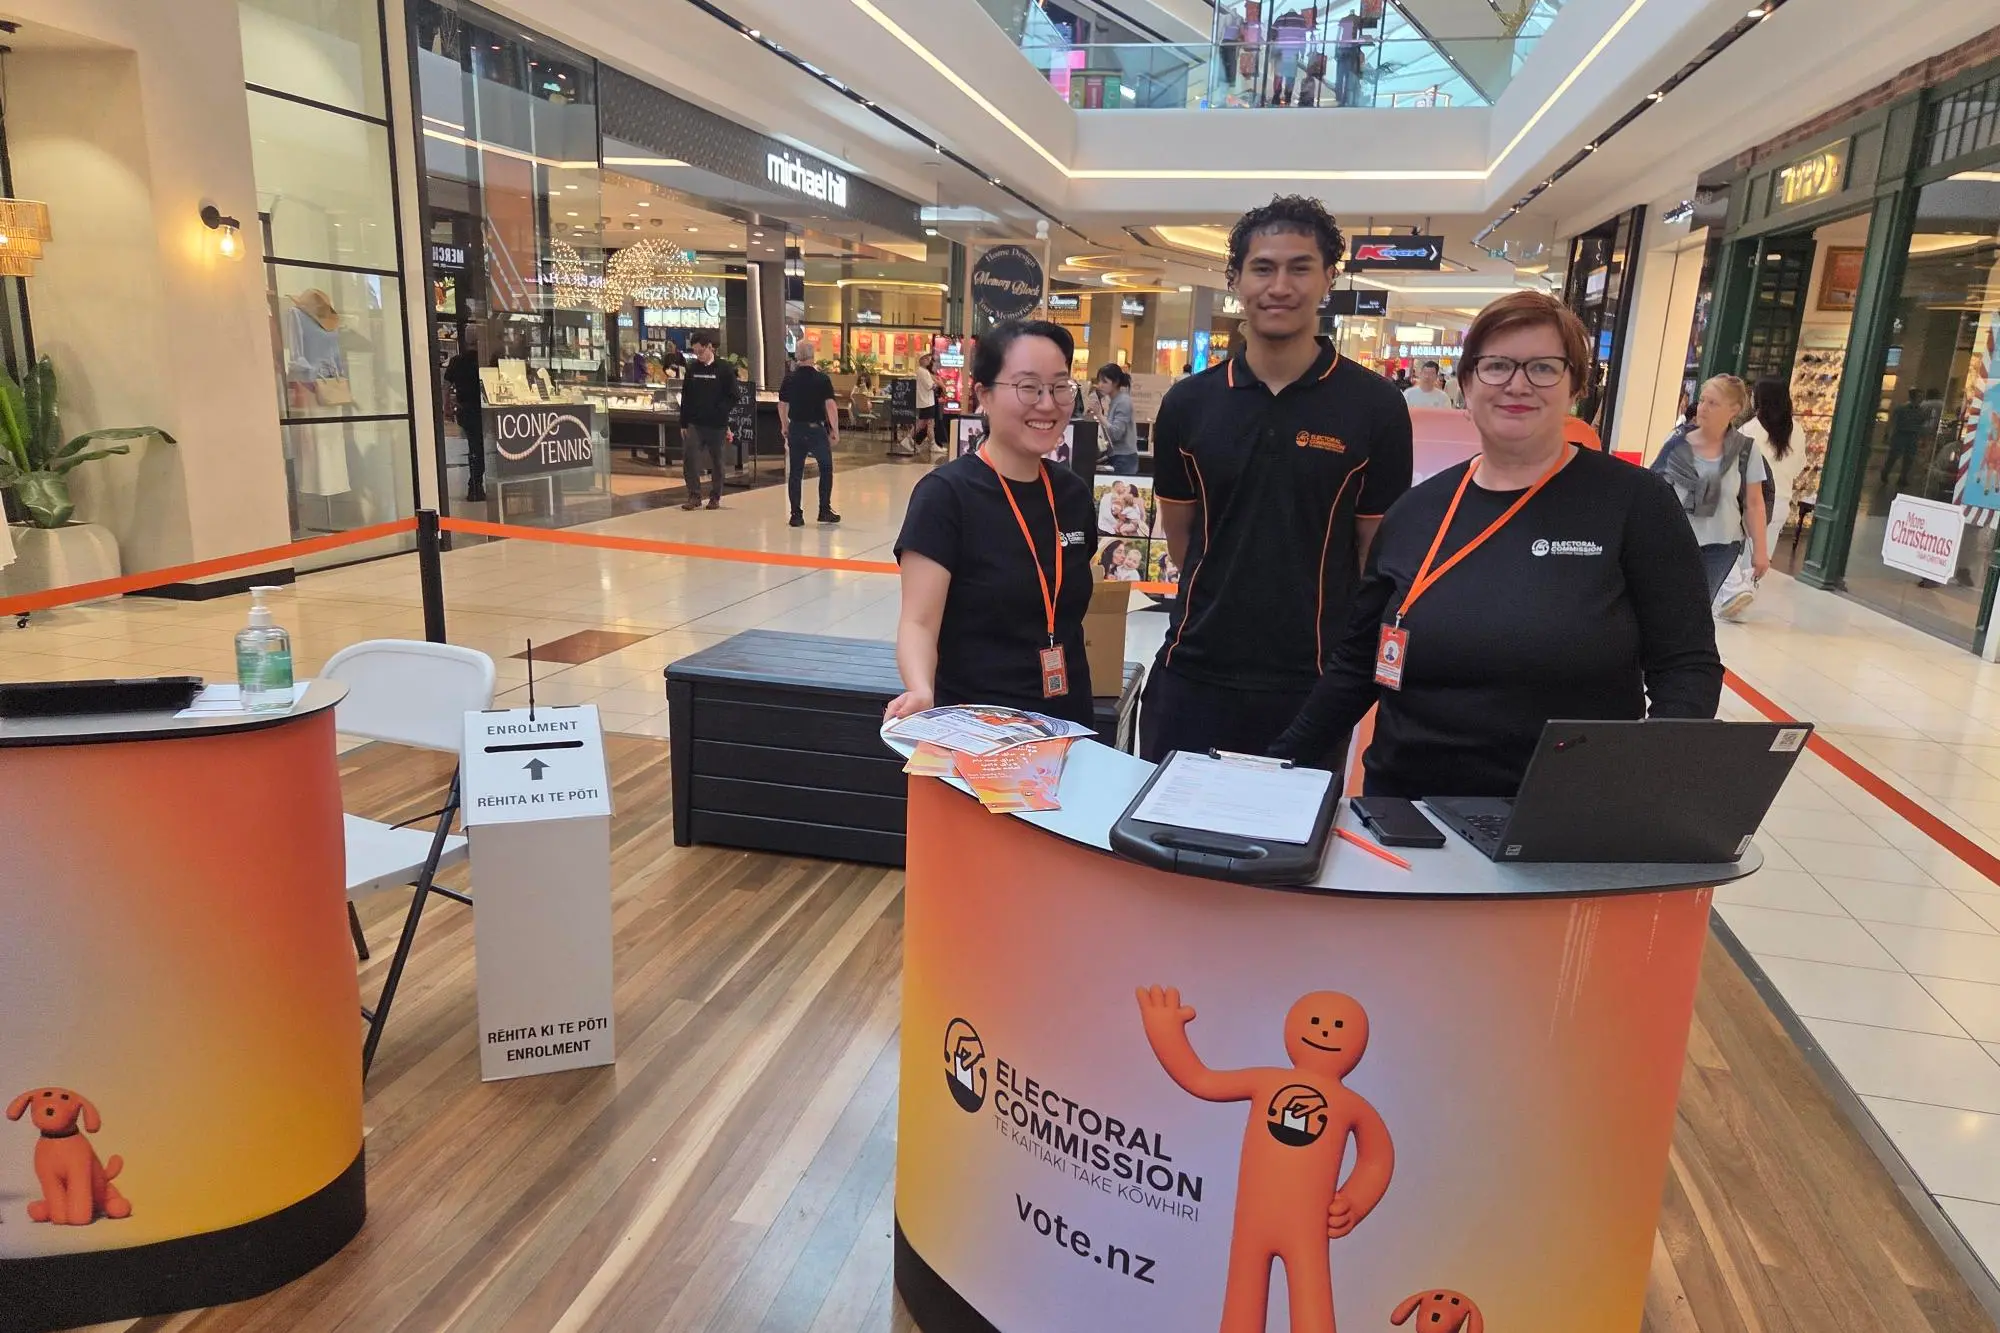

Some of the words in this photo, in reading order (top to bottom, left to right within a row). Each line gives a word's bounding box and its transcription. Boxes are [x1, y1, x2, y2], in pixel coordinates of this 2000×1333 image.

[767, 152, 827, 201] michael
[828, 171, 846, 208] hill
[985, 249, 1009, 262] Home
[1013, 248, 1036, 268] Design
[1355, 244, 1429, 260] Kmart
[974, 271, 1011, 290] Memory
[1012, 281, 1040, 296] Block
[996, 303, 1033, 320] Memories
[497, 412, 560, 439] ICONIC
[540, 437, 592, 464] TENNIS
[1891, 519, 1953, 557] Christmas
[487, 721, 578, 735] ENROLMENT
[477, 794, 527, 807] RĒHITA
[531, 793, 545, 803] KI
[548, 791, 565, 802] TE
[568, 788, 598, 801] PŌTI
[487, 1027, 537, 1044] RĒHITA
[541, 1024, 554, 1037] KI
[558, 1022, 574, 1034] TE
[578, 1017, 607, 1032] PŌTI
[507, 1040, 591, 1061] ENROLMENT
[996, 1058, 1172, 1162] ELECTORAL
[994, 1089, 1203, 1203] COMMISSION
[992, 1114, 1009, 1137] TE
[1011, 1126, 1066, 1173] KAITIAKI
[1070, 1163, 1112, 1194] TAKE
[1117, 1183, 1199, 1222] KŌWHIRI
[1015, 1193, 1156, 1284] vote.nz
